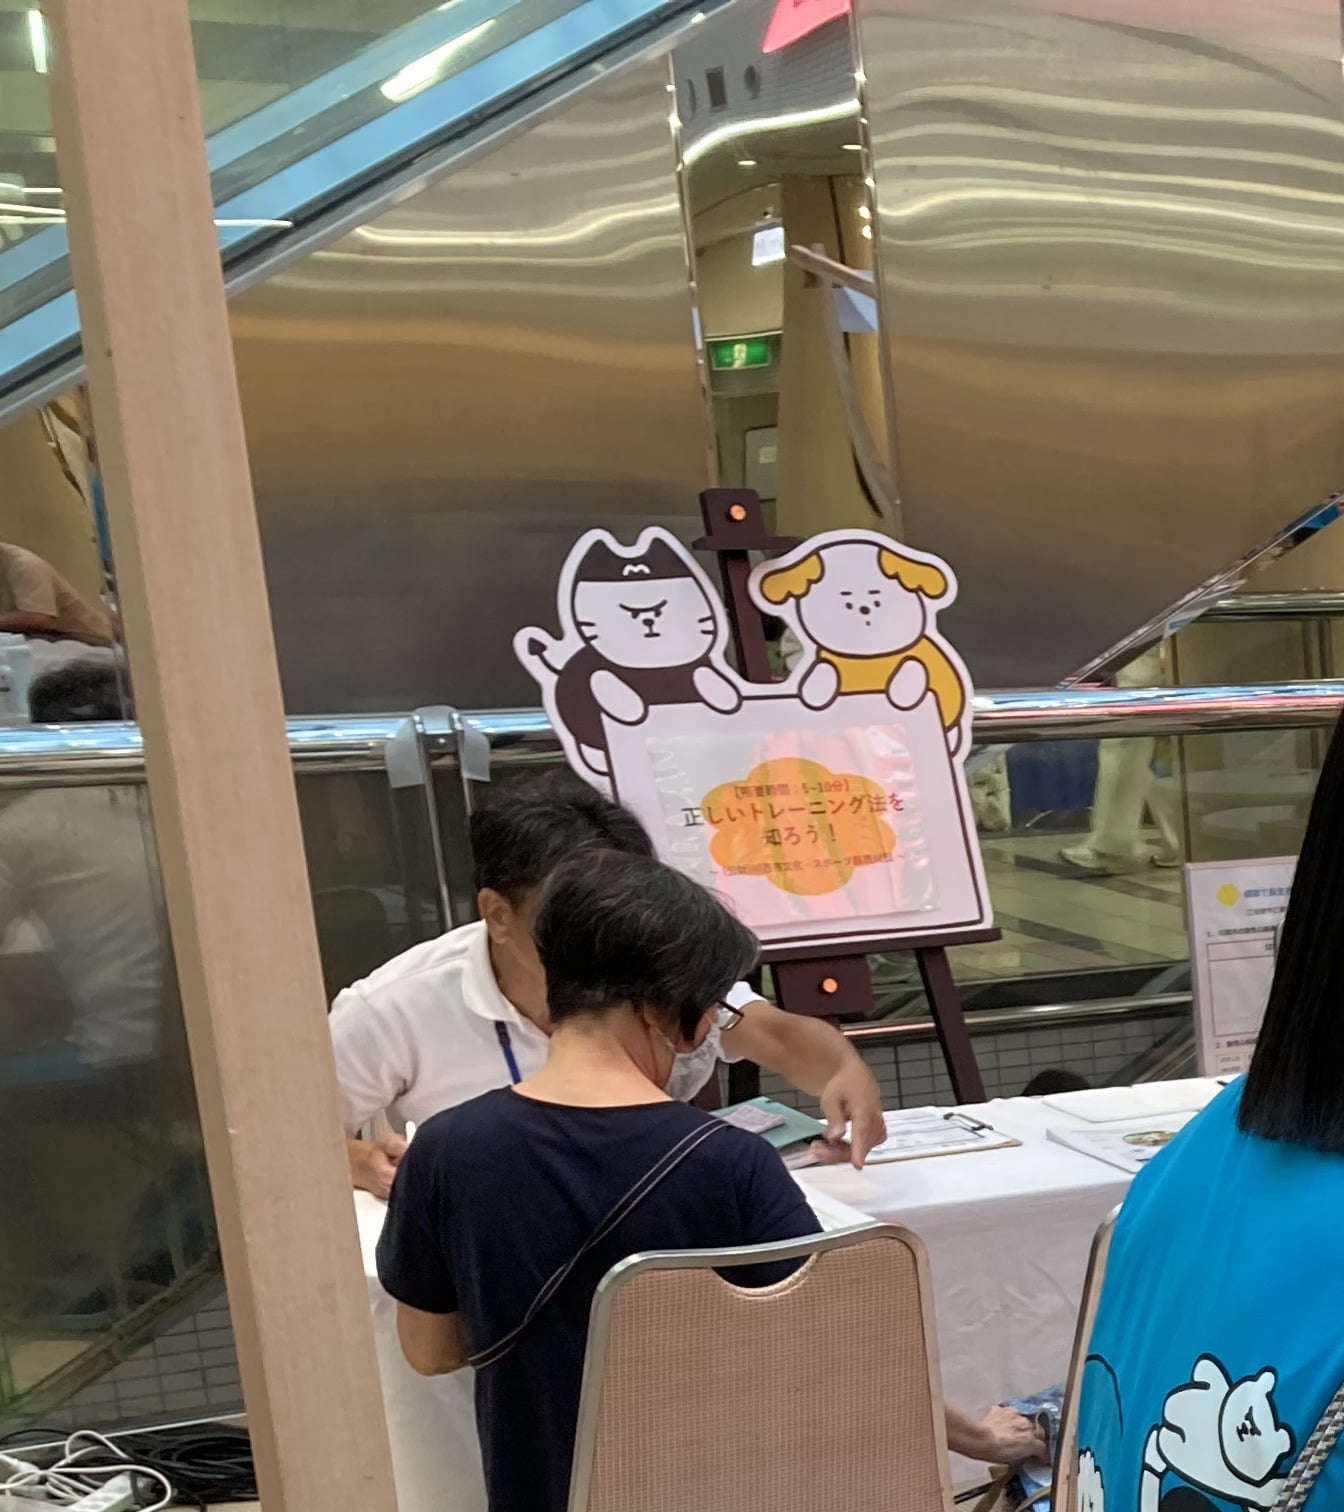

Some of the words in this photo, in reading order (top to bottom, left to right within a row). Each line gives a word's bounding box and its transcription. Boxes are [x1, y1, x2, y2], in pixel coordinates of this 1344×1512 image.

[681, 791, 905, 827] 正しいトレーニング法を
